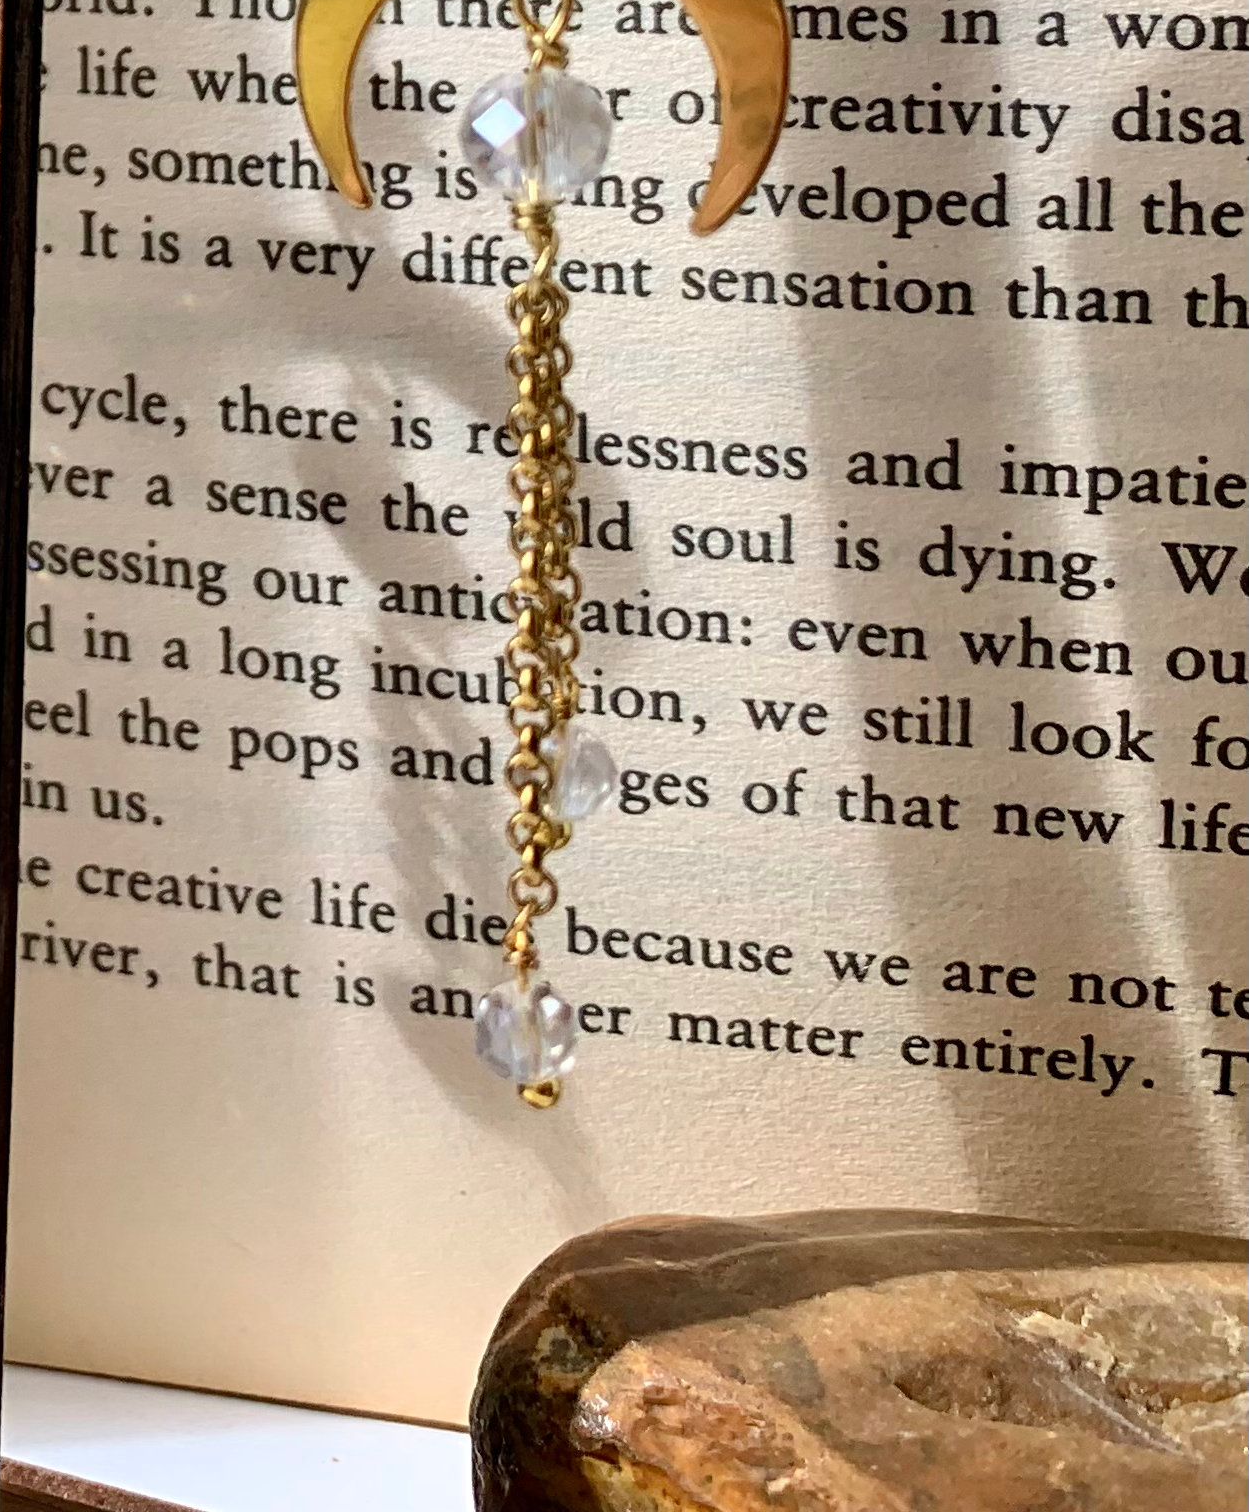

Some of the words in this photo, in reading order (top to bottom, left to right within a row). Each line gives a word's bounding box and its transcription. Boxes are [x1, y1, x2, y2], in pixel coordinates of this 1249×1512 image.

[76, 44, 157, 100] life
[1035, 10, 1070, 48] a
[1036, 175, 1115, 233] all
[1139, 178, 1246, 239] the
[140, 214, 182, 265] is
[256, 238, 376, 293] very
[681, 259, 977, 317] sensation
[1004, 264, 1154, 325] than
[40, 372, 188, 439] cycle,
[217, 382, 360, 445] there
[389, 399, 433, 451] is
[205, 479, 349, 527] sense
[380, 481, 470, 537] the
[671, 512, 796, 565] soul
[918, 523, 1116, 601] dying.
[252, 566, 350, 607] our
[787, 617, 931, 662] even
[958, 615, 1133, 677] when
[83, 611, 133, 664] in
[218, 625, 341, 701] long
[863, 694, 975, 749] still
[1007, 700, 1156, 763] look
[89, 786, 164, 827] us.
[117, 696, 201, 753] the
[228, 725, 360, 781] pops
[741, 766, 809, 818] of
[992, 802, 1126, 845] new
[75, 863, 284, 920] creative
[310, 876, 397, 934] life
[564, 905, 794, 976] because
[941, 960, 1038, 999] are
[1067, 971, 1177, 1013] not
[20, 919, 160, 990] river,
[334, 959, 376, 1008] is
[666, 1011, 865, 1060] matter
[900, 1028, 1155, 1098] entirely.
